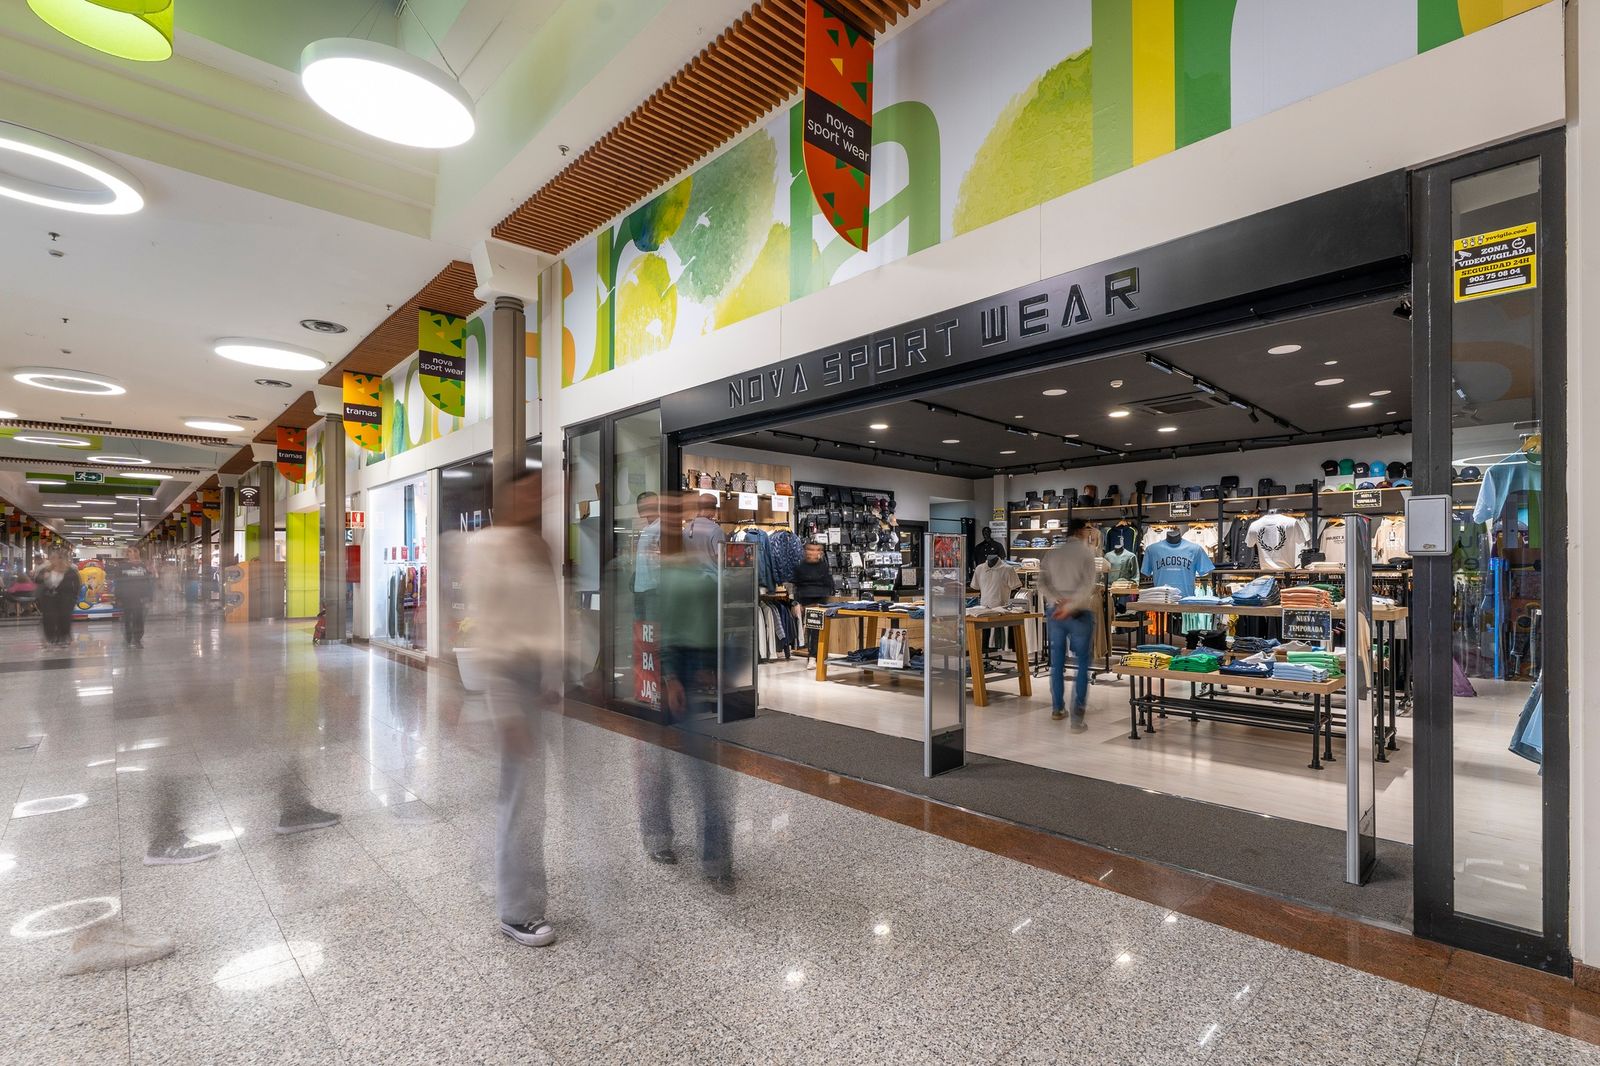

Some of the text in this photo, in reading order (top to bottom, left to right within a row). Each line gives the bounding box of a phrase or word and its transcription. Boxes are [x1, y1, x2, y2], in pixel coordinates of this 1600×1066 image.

[826, 113, 854, 138] nova
[808, 119, 869, 162] sport wear
[1459, 247, 1533, 267] VIDEOVIGILADA
[1481, 244, 1509, 255] ZONA
[1461, 258, 1530, 276] SEGURIDAD 24H
[1469, 275, 1485, 283] 902
[728, 267, 1140, 408] NOVA SPORT WEAR
[420, 363, 464, 376] sport wear
[432, 357, 453, 367] nova
[346, 407, 377, 417] tramas
[1156, 556, 1192, 570] LACOSTE
[642, 624, 654, 642] RE
[1288, 625, 1323, 633] TEMPORADA
[642, 652, 654, 671] BA
